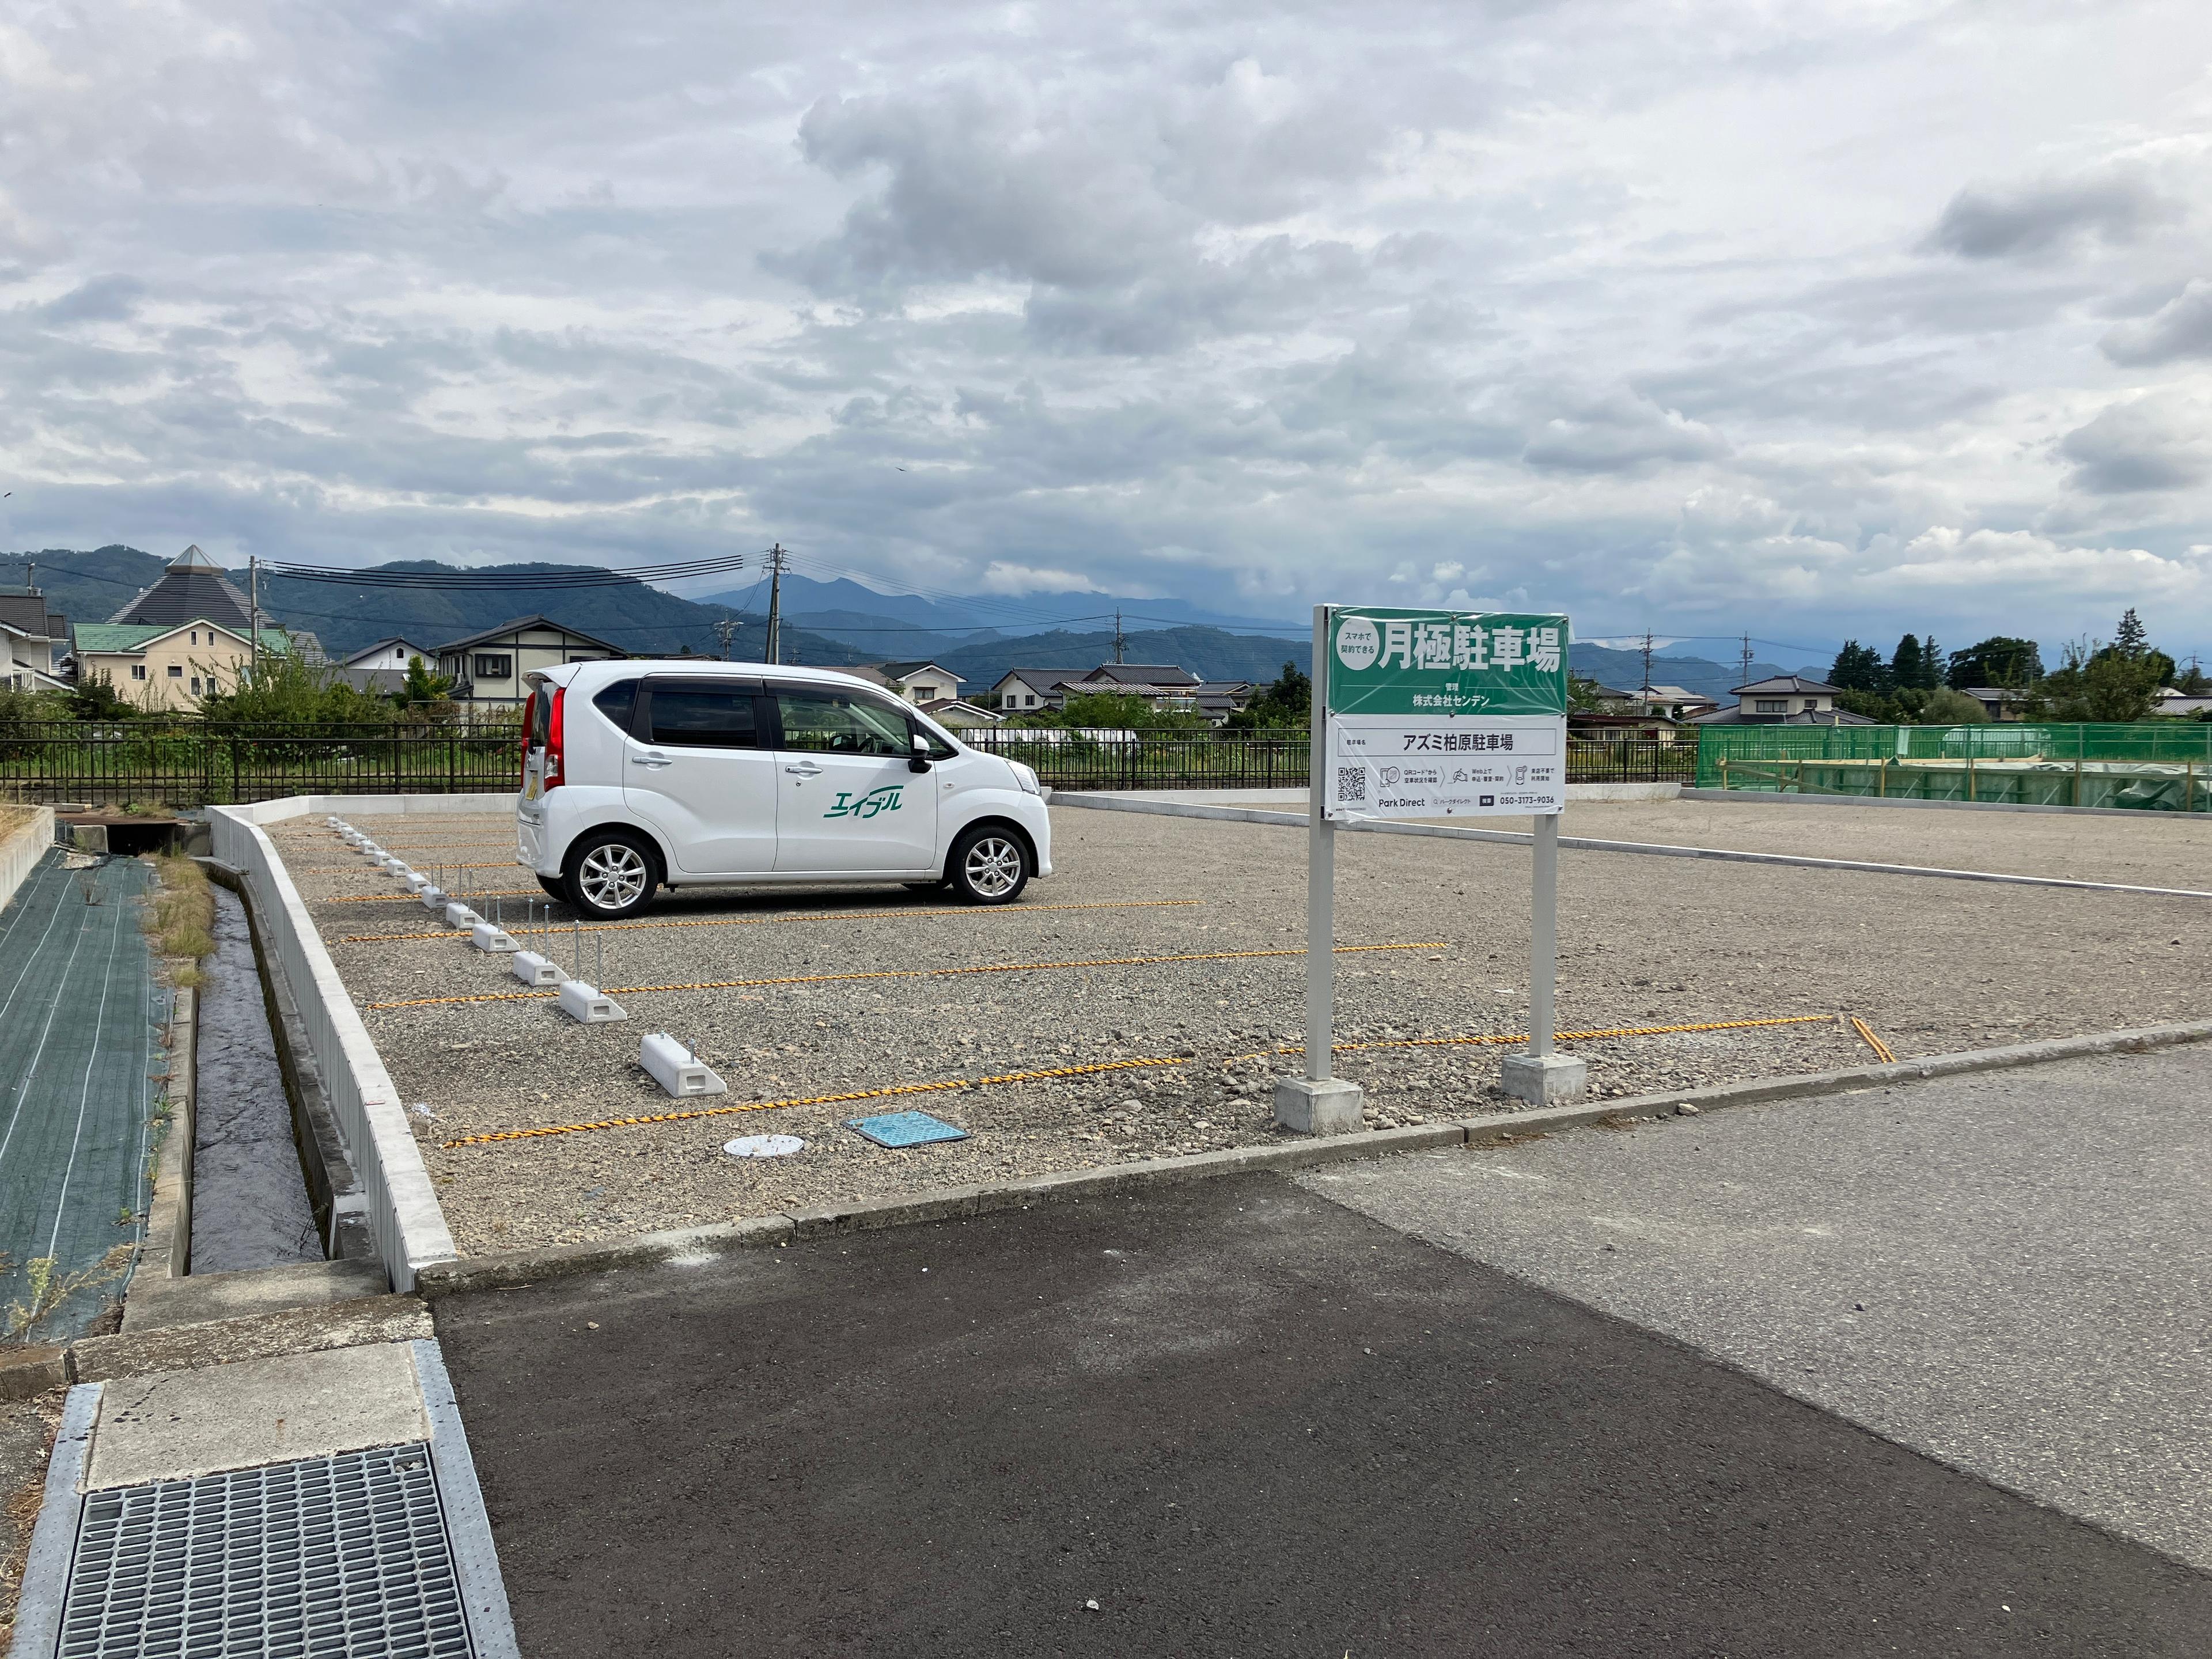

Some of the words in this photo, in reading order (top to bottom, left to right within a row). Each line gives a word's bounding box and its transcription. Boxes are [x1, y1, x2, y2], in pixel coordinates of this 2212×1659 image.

[1345, 632, 1372, 641] スマホで
[1340, 645, 1374, 654] 契約できる
[1378, 623, 1560, 673] 月極駐車場
[1445, 683, 1459, 691] 管理
[1412, 694, 1490, 707] 株式会社センデン
[1403, 733, 1513, 751] アズミ柏原駐車場
[823, 785, 904, 819] エイブル
[1379, 799, 1397, 807] Park
[1400, 798, 1425, 806] Direct
[1500, 796, 1554, 804] 050-3173-9036
